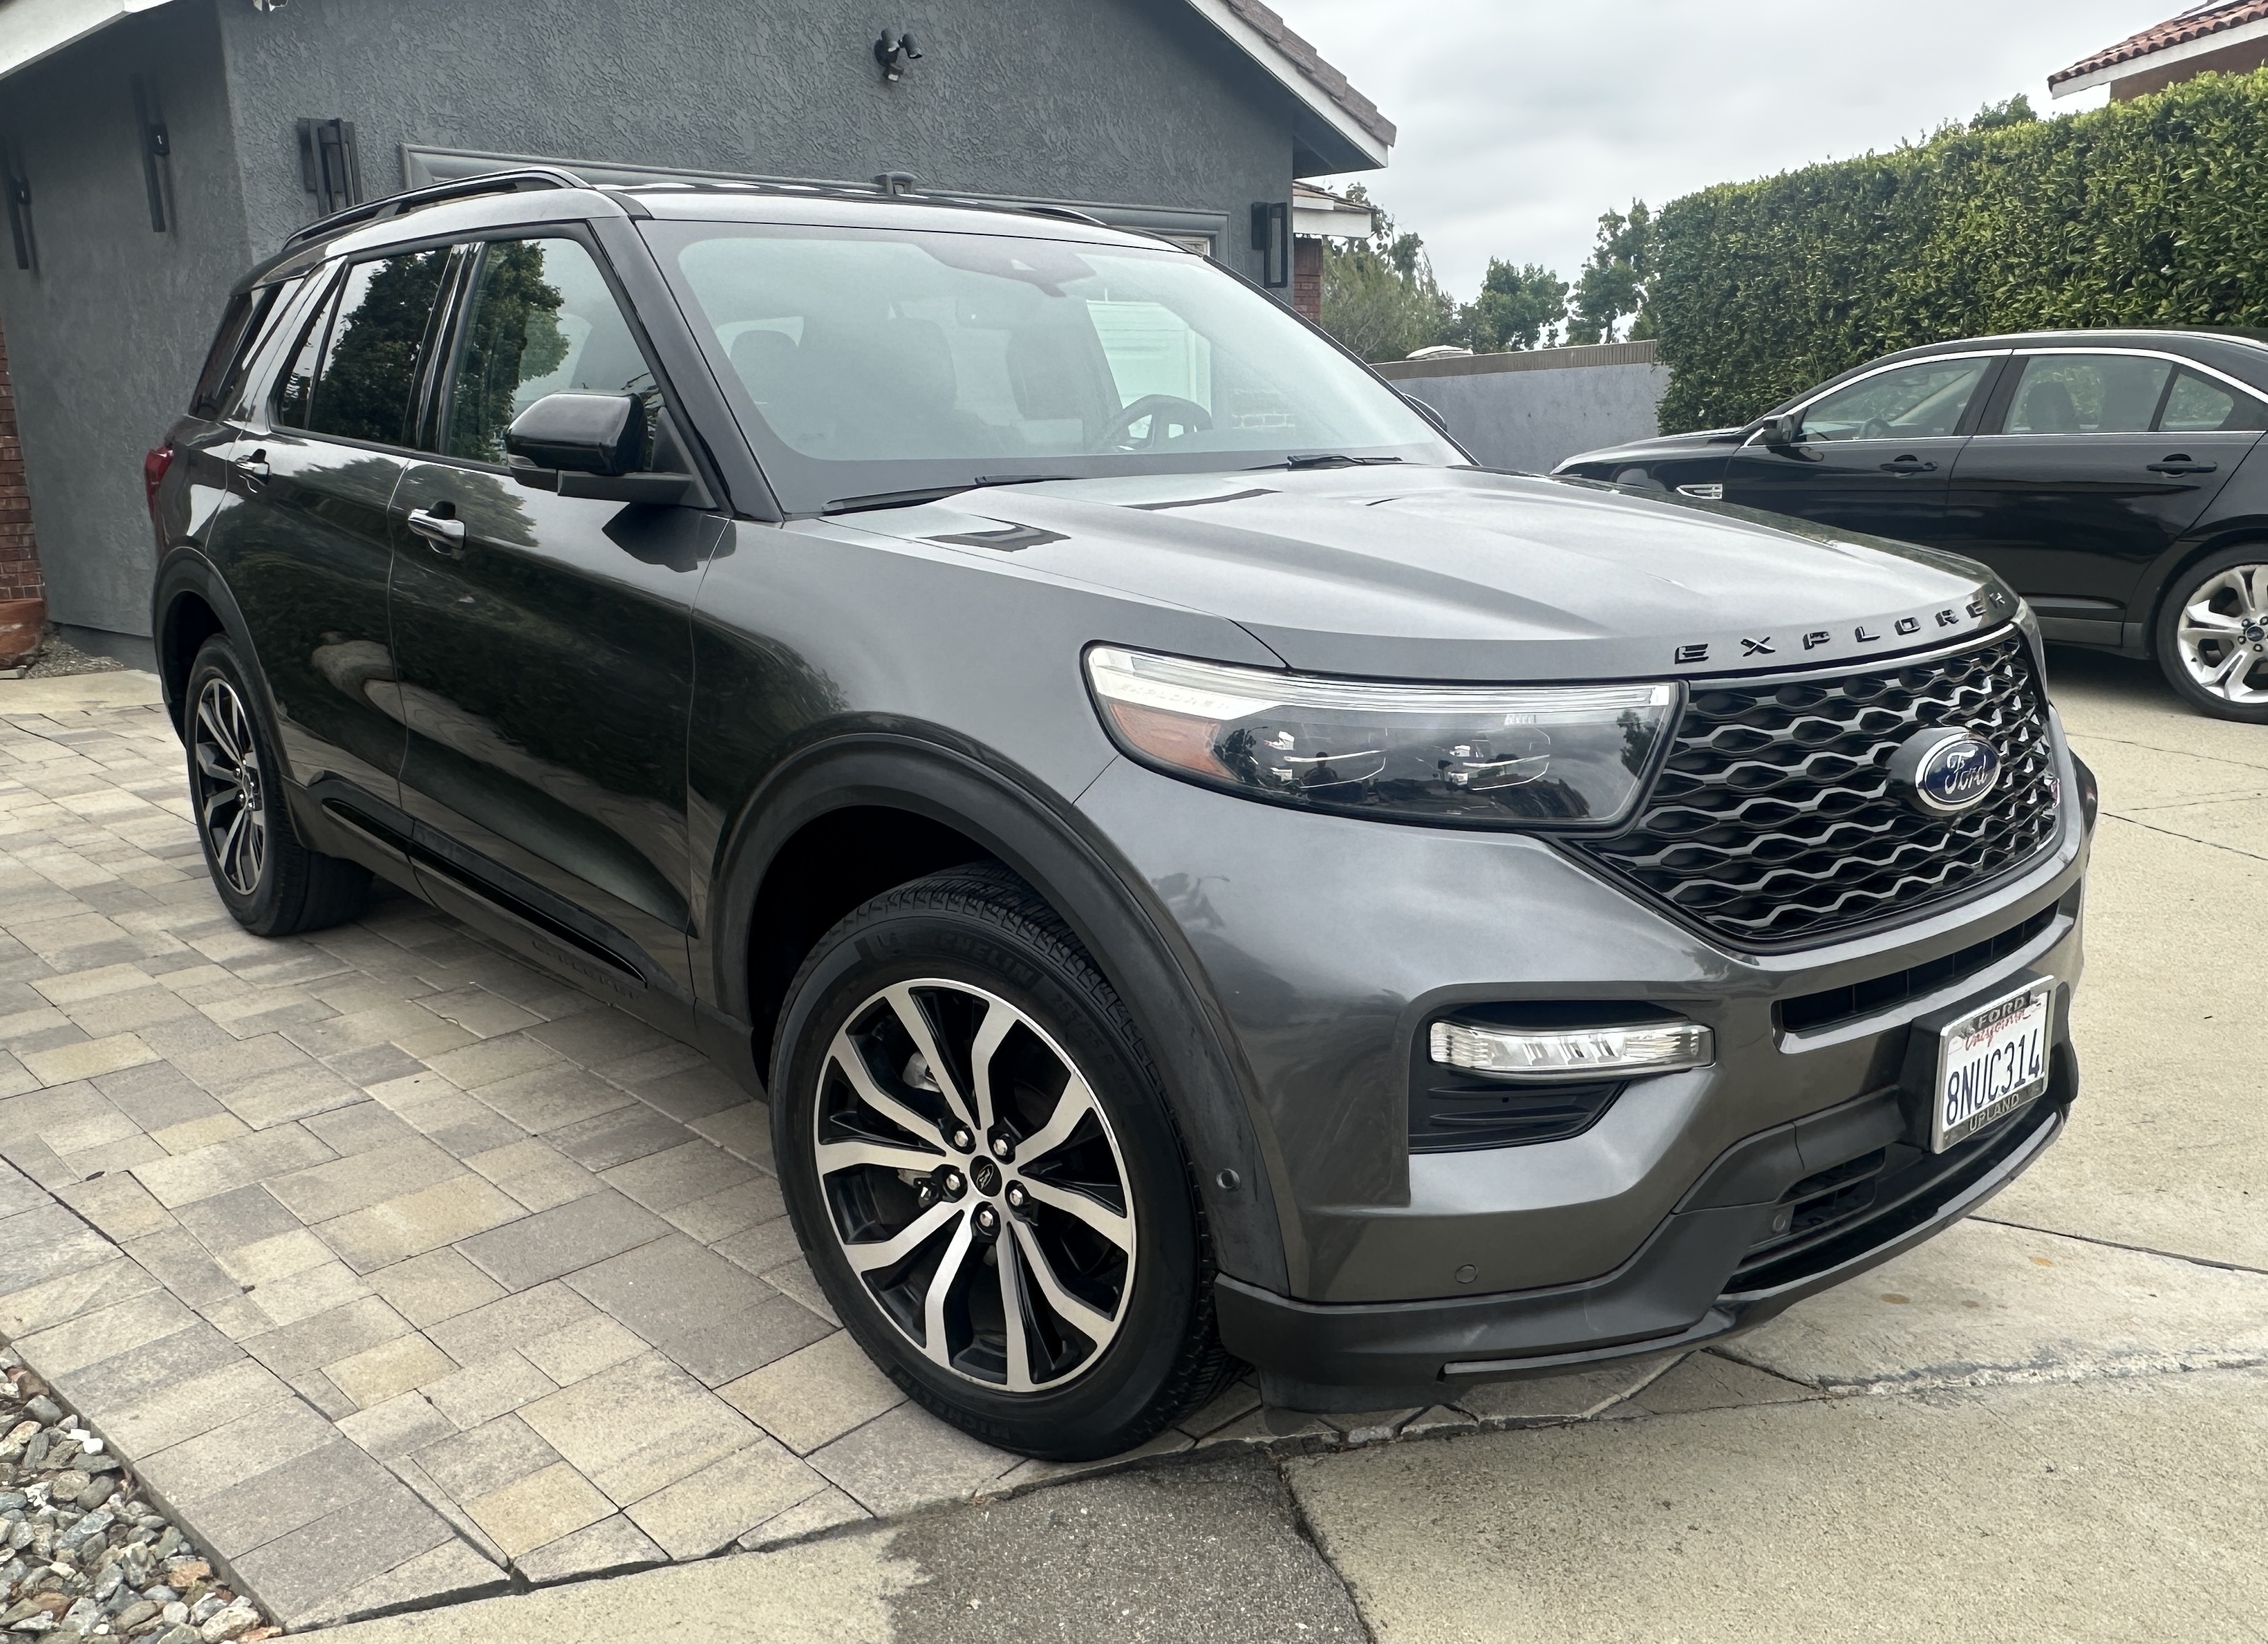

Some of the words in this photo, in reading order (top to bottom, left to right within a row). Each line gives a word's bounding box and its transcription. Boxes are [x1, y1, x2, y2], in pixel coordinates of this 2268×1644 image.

[1674, 592, 2005, 664] EXPLORER
[1944, 749, 1988, 794] Ford
[1978, 996, 2025, 1029] FORD
[1946, 1028, 2040, 1126] 8NUC314
[1969, 1093, 2020, 1132] UPLAND
